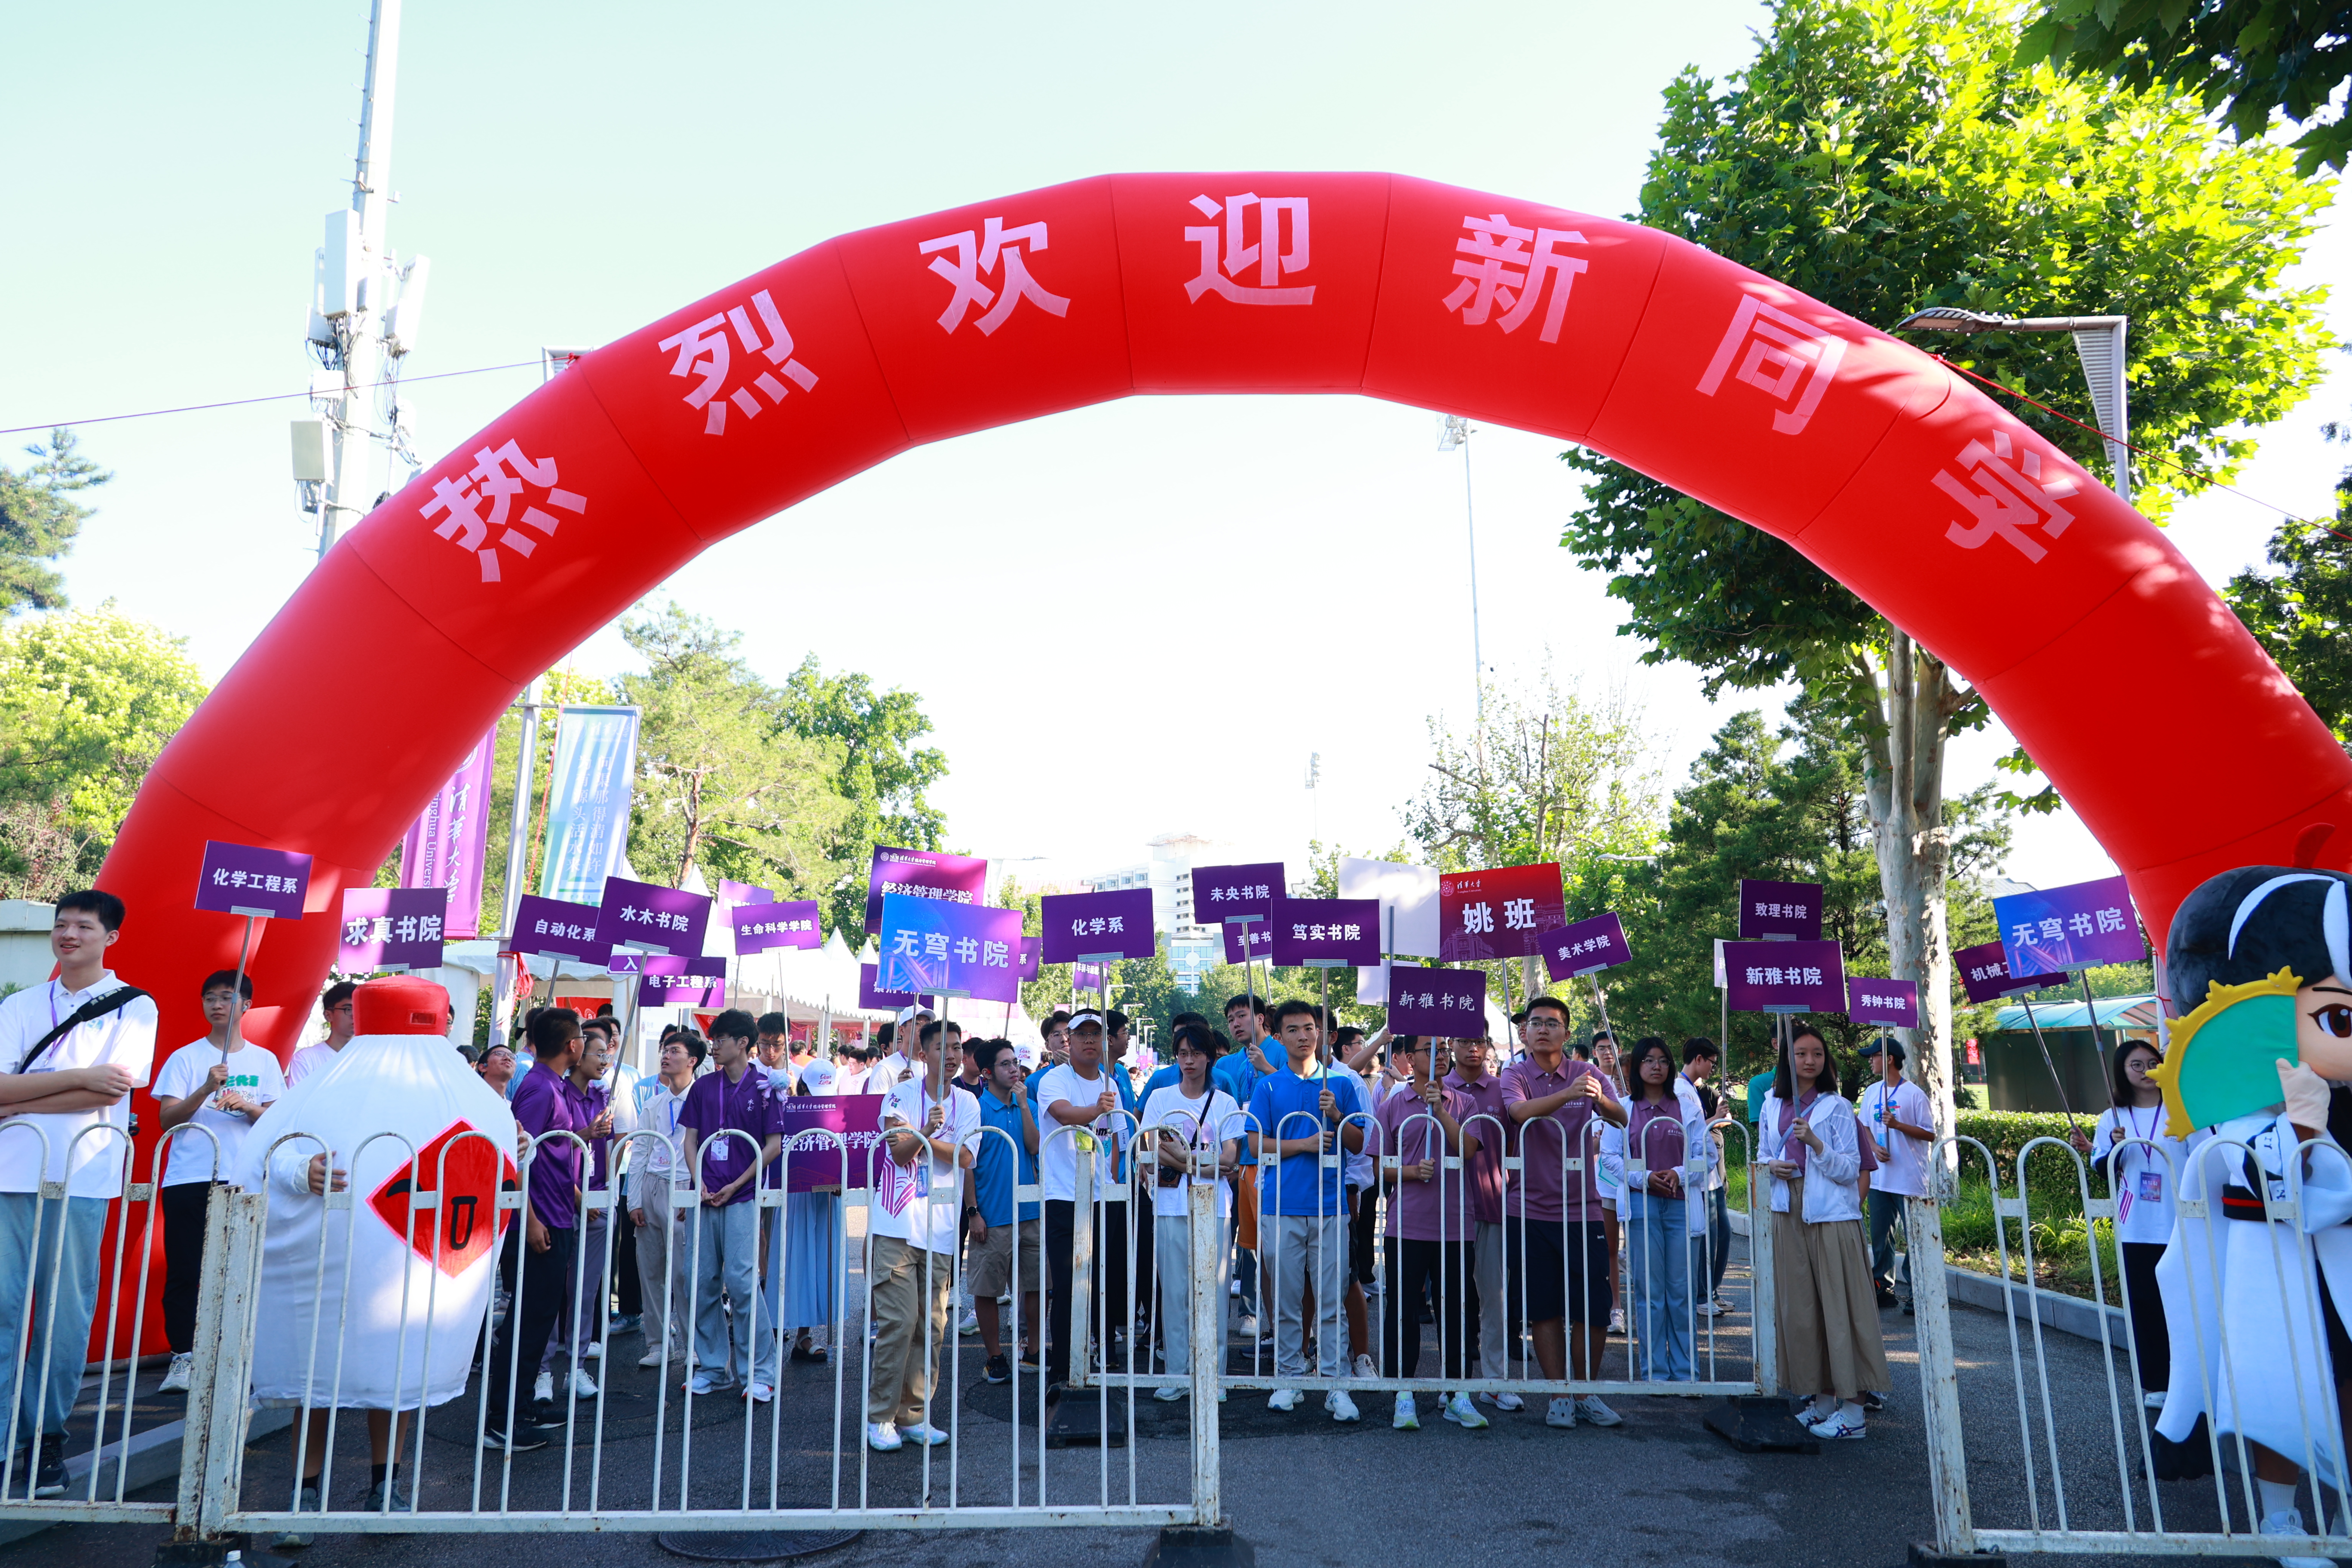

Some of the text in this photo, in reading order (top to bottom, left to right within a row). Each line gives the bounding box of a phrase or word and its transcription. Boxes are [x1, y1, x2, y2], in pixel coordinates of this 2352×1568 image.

[419, 192, 2080, 582] 热烈欢迎新同学
[565, 755, 592, 873] 为有源头活水来
[588, 755, 612, 873] 问渠那得清如许
[212, 867, 298, 894] 化学工程系
[1210, 884, 1270, 902] 未央书院
[619, 905, 689, 932] 水木书院
[1462, 897, 1537, 934] 姚班
[1755, 902, 1807, 919] 致理书院
[345, 914, 441, 946] 求真书院
[534, 919, 595, 942] 自动化系
[741, 919, 813, 936] 生命科学学院
[1072, 916, 1124, 937] 化学系
[1292, 924, 1361, 941] 笃实书院
[2012, 906, 2126, 948] 无穹书院
[892, 929, 1009, 968] 无穹书院
[1558, 934, 1611, 961] 美术学院
[649, 974, 717, 988] 电子工程系
[1746, 967, 1823, 986] 新雅书院
[1399, 990, 1476, 1011] 新雅书院
[1861, 994, 1906, 1010] 秀钟书院
